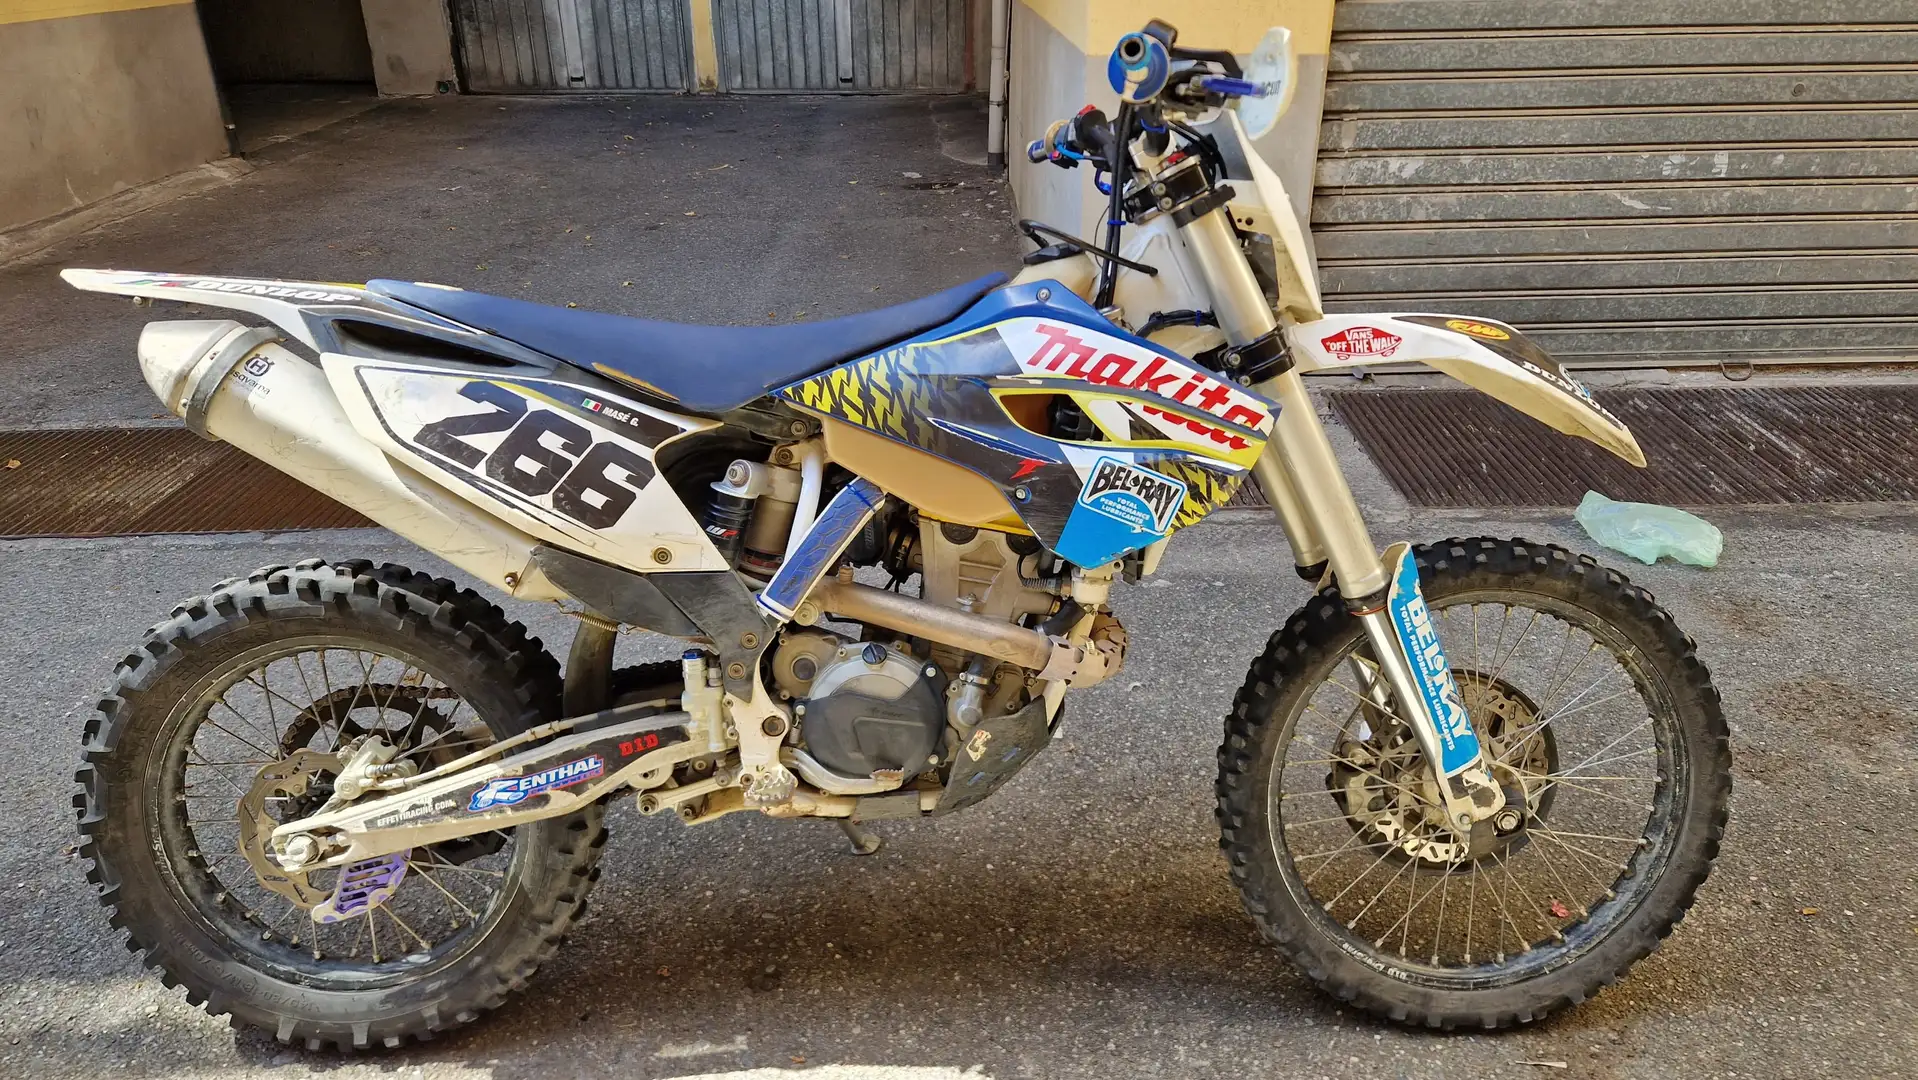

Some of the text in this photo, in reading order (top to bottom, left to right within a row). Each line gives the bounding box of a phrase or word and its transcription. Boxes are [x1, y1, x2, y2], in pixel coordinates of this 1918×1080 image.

[186, 280, 362, 301] DUNLOP
[1344, 328, 1374, 341] VANS
[1349, 339, 1370, 354] THE
[1027, 323, 1265, 438] makita
[601, 406, 632, 423] MASÉ
[413, 380, 656, 530] 266
[1100, 497, 1151, 521] PERFORMANCE
[1116, 496, 1138, 510] TOTAL
[1399, 605, 1456, 751] TOTAL PERFORMANCE LUBRICANTS
